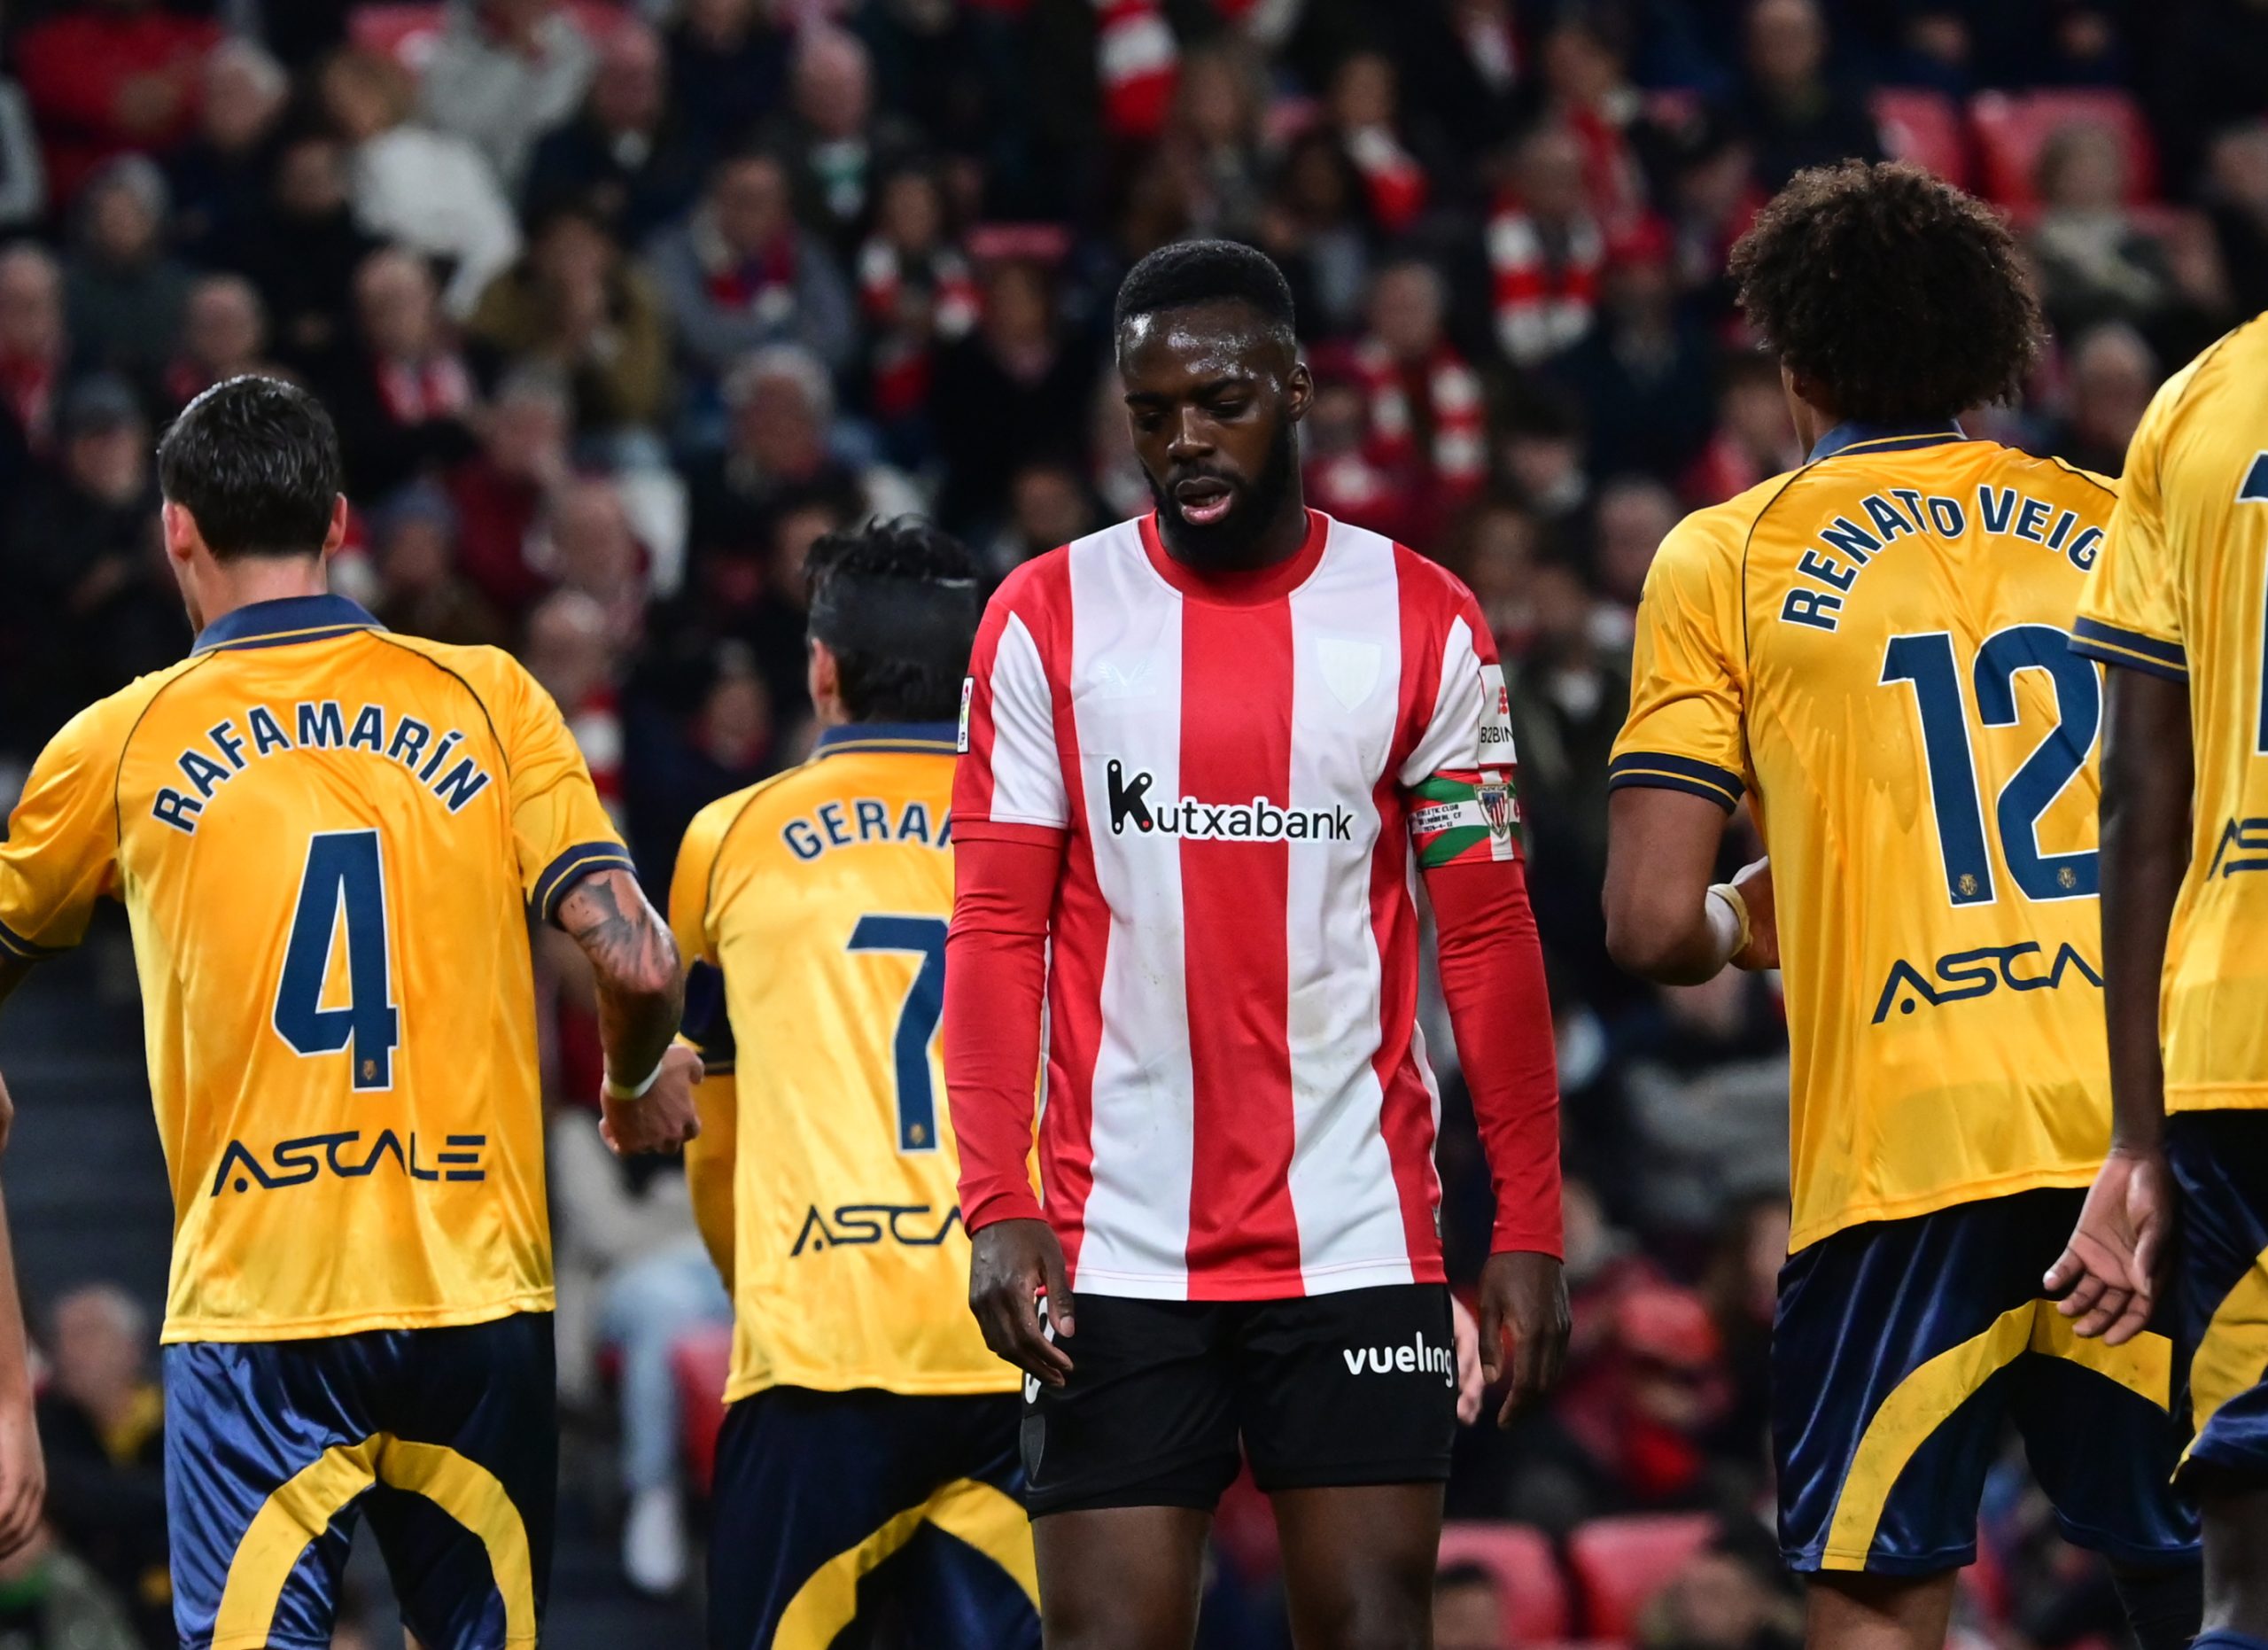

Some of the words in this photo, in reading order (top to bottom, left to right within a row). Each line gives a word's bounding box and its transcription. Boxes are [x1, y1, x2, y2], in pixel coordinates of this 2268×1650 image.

[1779, 487, 1967, 633] RENATO
[1977, 483, 2105, 573] VEIG
[1107, 759, 1354, 841] Kutxabank
[1877, 622, 2102, 908] 12
[271, 827, 399, 1093] 4
[845, 913, 949, 1152] 7
[211, 1128, 486, 1197] ASCALE
[1343, 1331, 1453, 1389] vueling
